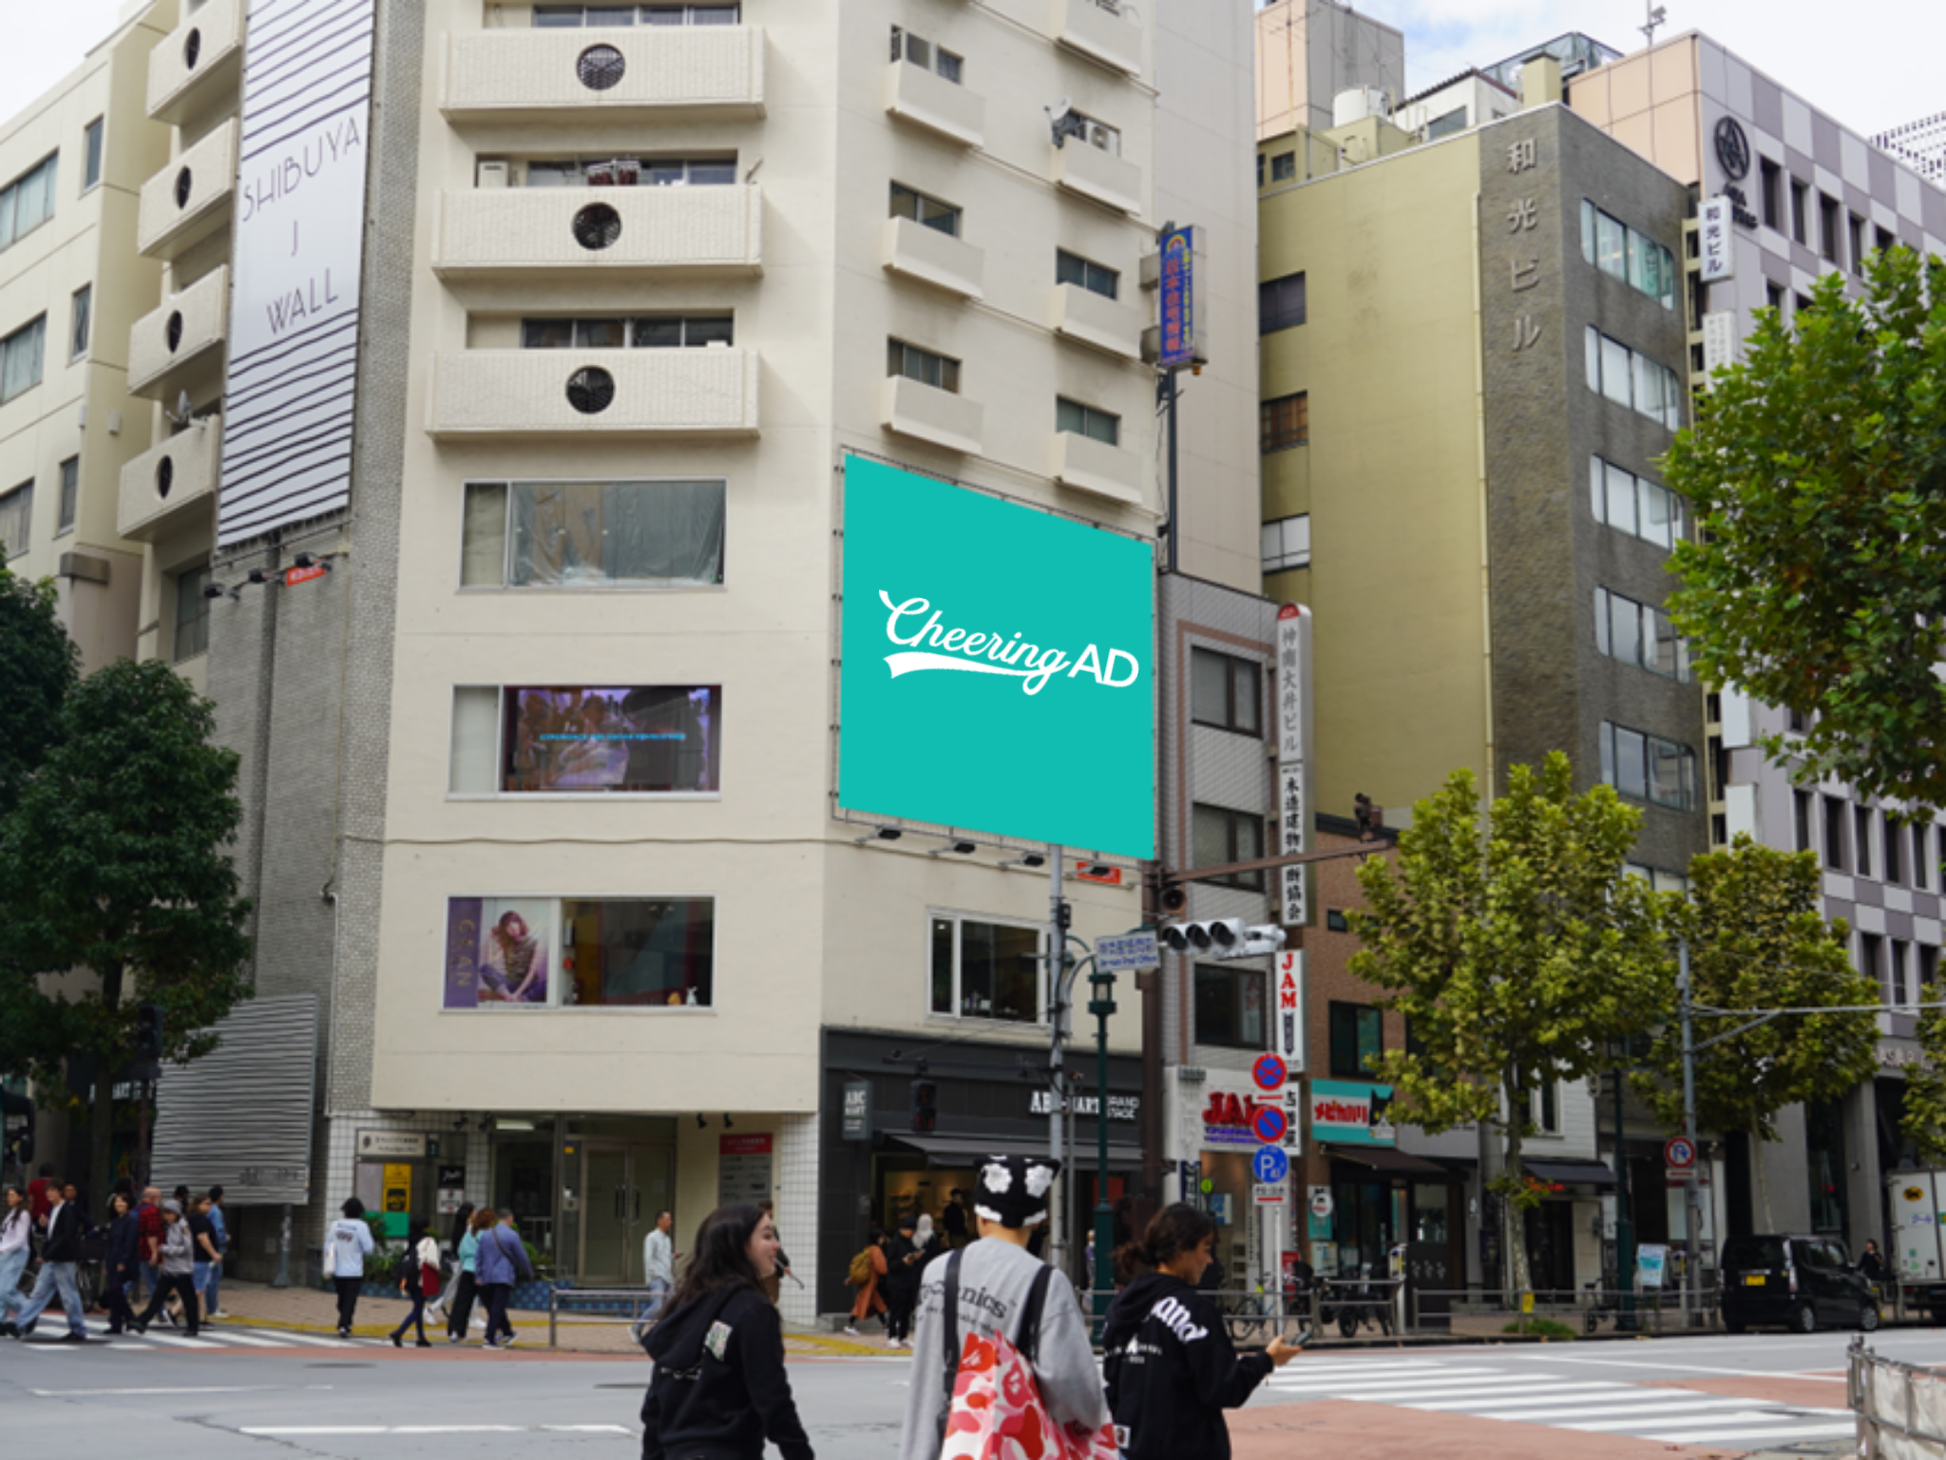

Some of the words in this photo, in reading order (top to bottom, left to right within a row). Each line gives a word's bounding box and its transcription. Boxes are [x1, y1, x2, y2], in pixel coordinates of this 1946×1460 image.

[242, 115, 361, 222] SHIBUYA
[289, 219, 300, 257] J
[1505, 136, 1542, 353] 和光ビル
[1705, 206, 1723, 274] 和光ビル
[266, 268, 339, 335] WALL
[1280, 952, 1298, 1010] JAM
